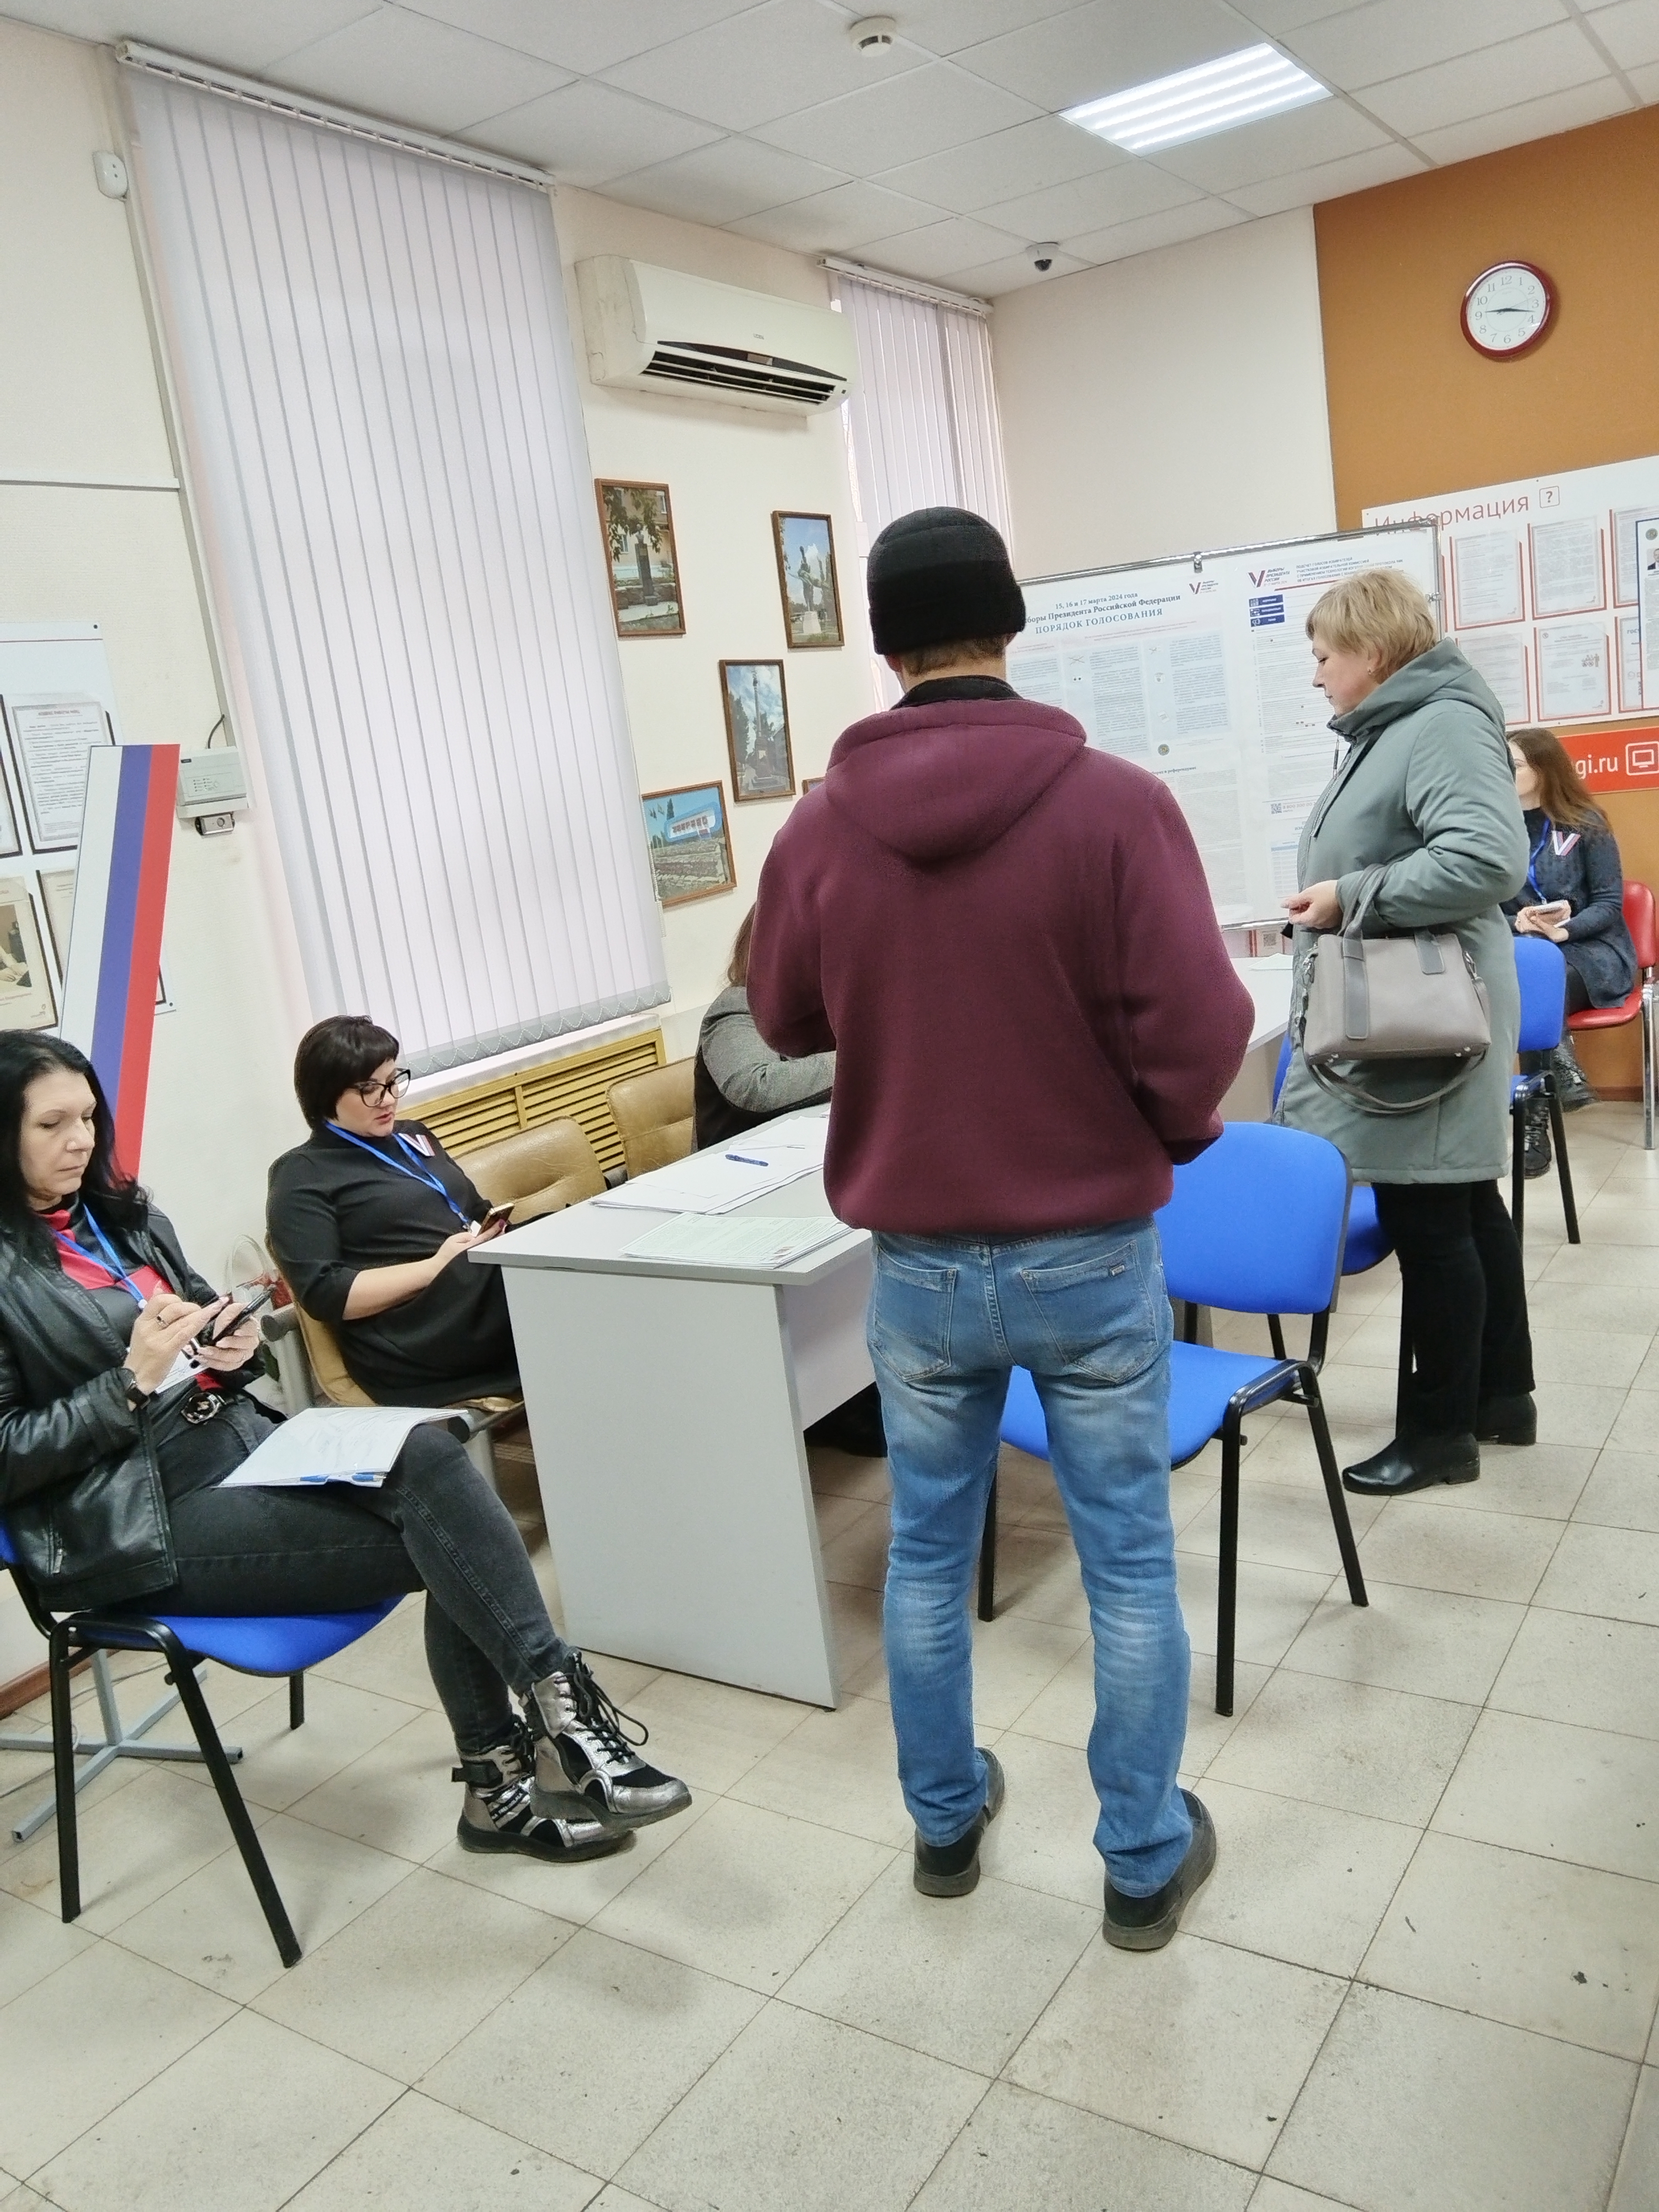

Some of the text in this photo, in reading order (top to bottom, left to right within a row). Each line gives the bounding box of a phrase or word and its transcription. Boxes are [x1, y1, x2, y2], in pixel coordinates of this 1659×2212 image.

[1501, 275, 1512, 285] 12
[1519, 277, 1522, 286] 1
[1488, 283, 1495, 292] 11
[1528, 285, 1535, 295] 2
[1477, 296, 1488, 305] 10
[1532, 300, 1539, 308] 3
[1475, 311, 1482, 320] 9
[1528, 315, 1535, 324] 4
[1479, 325, 1486, 333] 8
[1519, 328, 1525, 337] 5
[1490, 333, 1498, 342] 7
[1504, 335, 1511, 343] 6
[1375, 497, 1528, 534] Ирмация
[1026, 595, 1181, 624] боры Президента Российской Федерации
[1036, 620, 1083, 634] ПОРЯДОК
[1086, 608, 1162, 626] ГОЛОСОВАНИЯ
[1575, 754, 1618, 779] gi.ru
